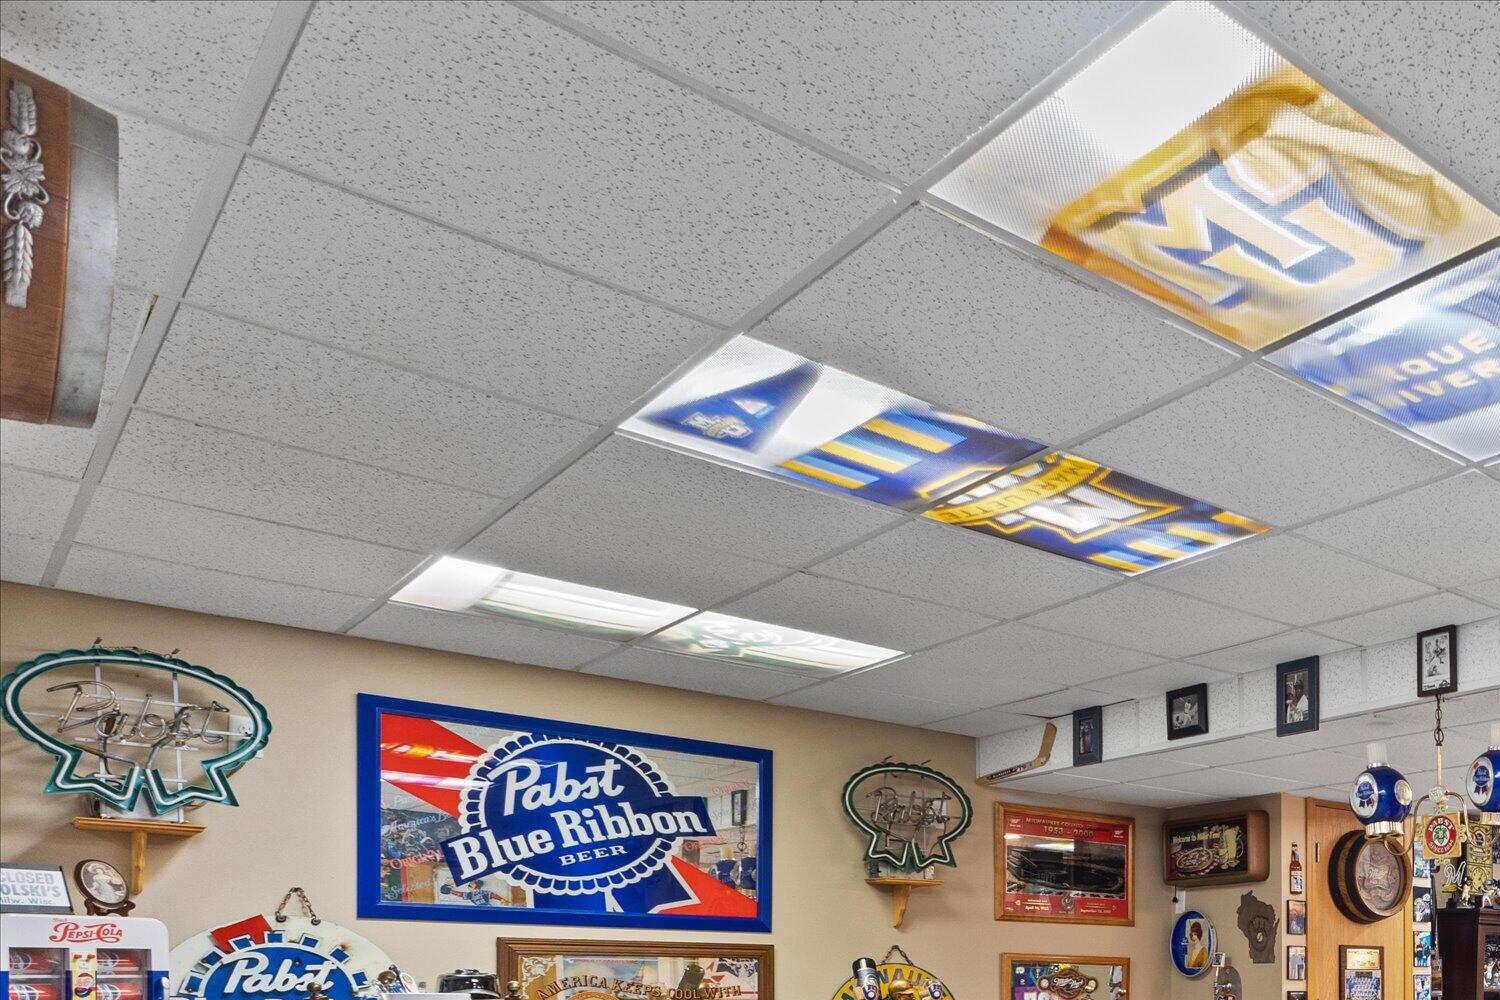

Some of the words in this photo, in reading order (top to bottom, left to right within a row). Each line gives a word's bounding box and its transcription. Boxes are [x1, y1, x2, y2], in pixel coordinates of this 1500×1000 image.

[47, 681, 229, 744] Pabst
[488, 758, 625, 816] Pabst
[448, 831, 555, 880] Blue
[550, 802, 707, 849] Ribbon
[1428, 817, 1455, 832] PABST
[559, 844, 628, 867] BEER
[222, 951, 335, 994] Pabst
[610, 979, 662, 999] KEEPS
[668, 987, 702, 1000] COOL
[703, 985, 742, 999] WITH
